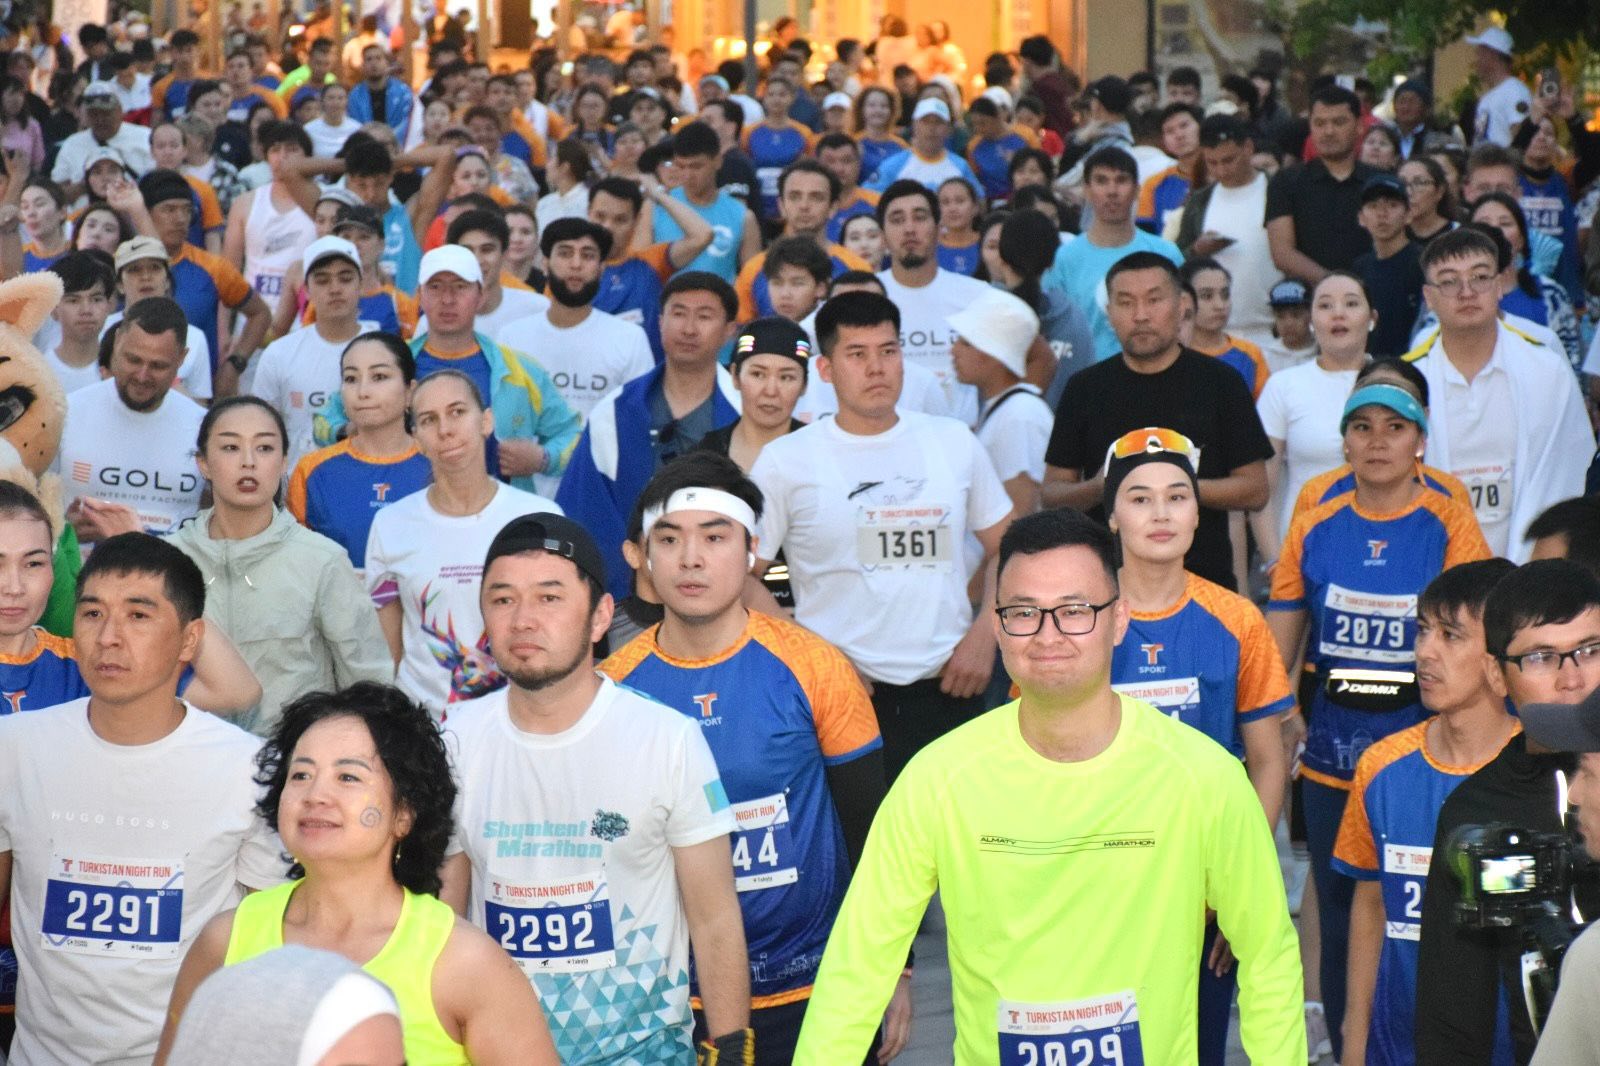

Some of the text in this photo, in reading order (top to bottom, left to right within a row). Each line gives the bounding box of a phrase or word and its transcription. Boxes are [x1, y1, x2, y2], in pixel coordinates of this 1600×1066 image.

[100, 467, 197, 492] GOLD
[95, 491, 146, 501] INTERIOR
[878, 529, 936, 559] 1361
[1335, 614, 1404, 648] 2079
[1138, 666, 1167, 674] SPORT
[1153, 687, 1173, 697] NIGHT
[1174, 686, 1189, 695] RUN
[1348, 684, 1400, 695] DEMIX
[51, 811, 170, 830] HUGO BOSS
[735, 804, 776, 821] NIGHT RUN
[496, 840, 603, 858] Marathon
[980, 836, 1017, 845] ALMATY
[1103, 839, 1155, 848] MARATHON
[78, 861, 124, 876] TURKISTAN
[125, 865, 150, 877] NIGHT
[153, 866, 171, 878] RUN
[505, 884, 549, 897] TURKISTAN
[549, 883, 575, 896] NIGHT
[577, 880, 594, 893] RUN
[66, 890, 160, 936] 2291
[499, 910, 595, 952] 2292
[1026, 1009, 1075, 1024] TURKISTAN
[1076, 1005, 1103, 1020] NIGHT
[1104, 1001, 1123, 1015] RUN
[1018, 1034, 1124, 1066] 2029
